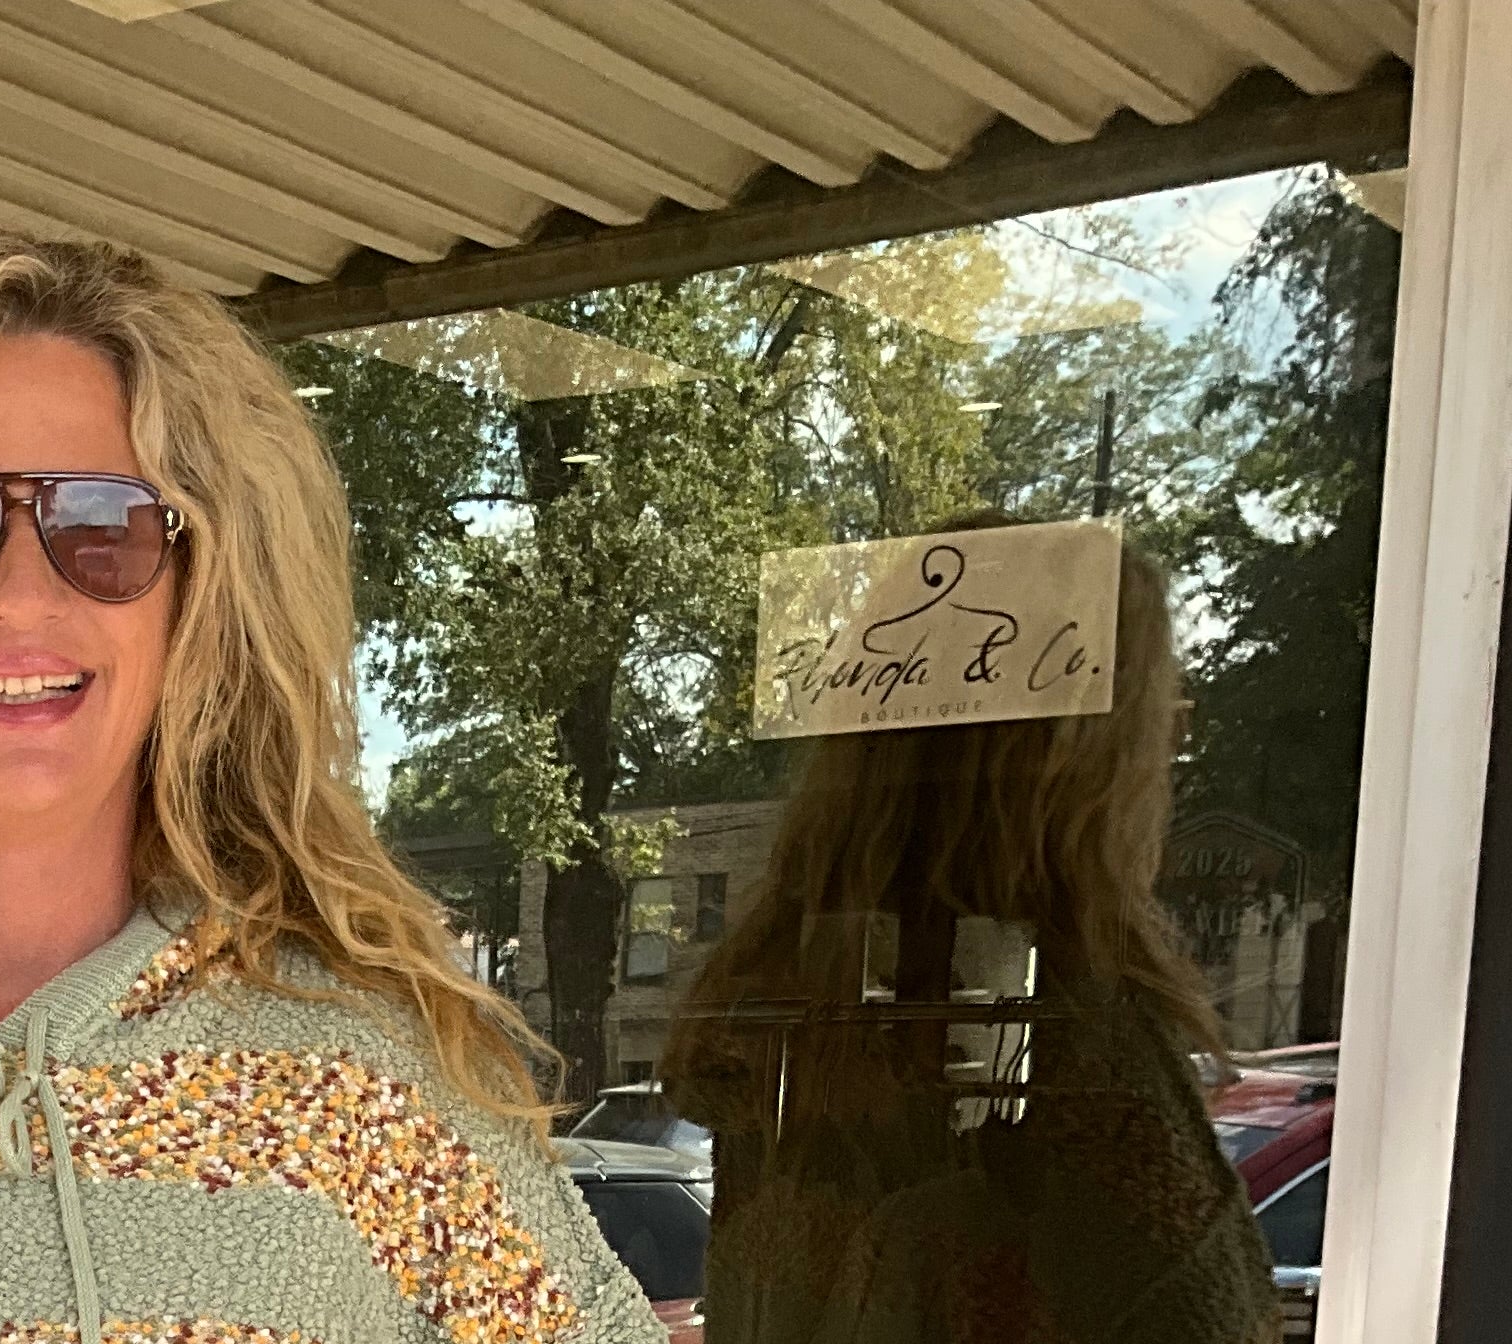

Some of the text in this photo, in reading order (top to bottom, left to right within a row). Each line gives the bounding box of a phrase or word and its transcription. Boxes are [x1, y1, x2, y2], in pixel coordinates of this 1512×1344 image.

[773, 621, 1101, 721] Rhonda & Co.
[860, 699, 983, 724] BOUTIQUE
[1175, 847, 1253, 879] 2025
